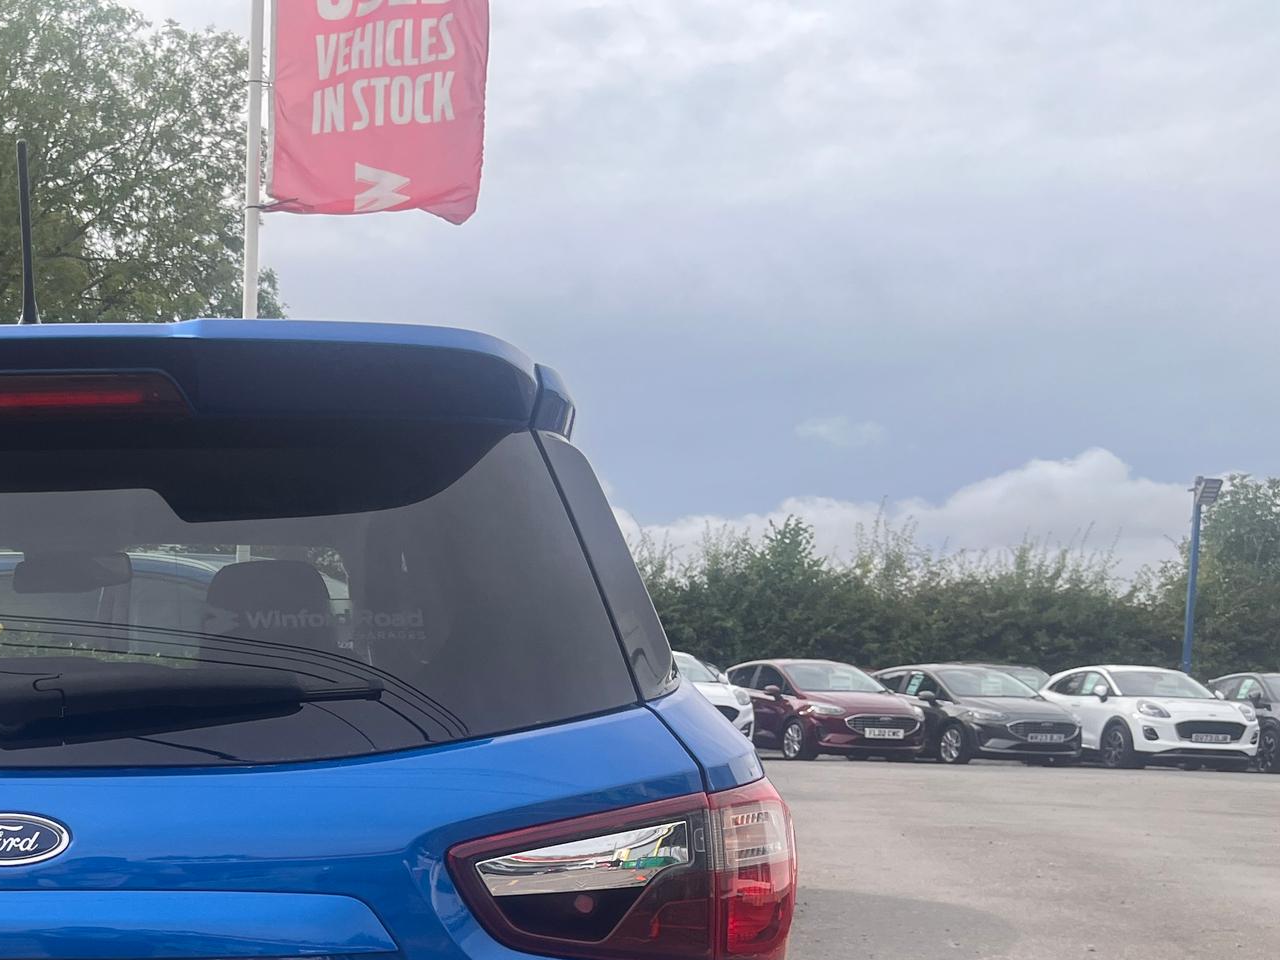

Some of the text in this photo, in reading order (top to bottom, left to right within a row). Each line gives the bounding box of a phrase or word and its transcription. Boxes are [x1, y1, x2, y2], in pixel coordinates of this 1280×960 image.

[315, 13, 455, 80] VEHICLES
[311, 71, 455, 135] IN STOCK
